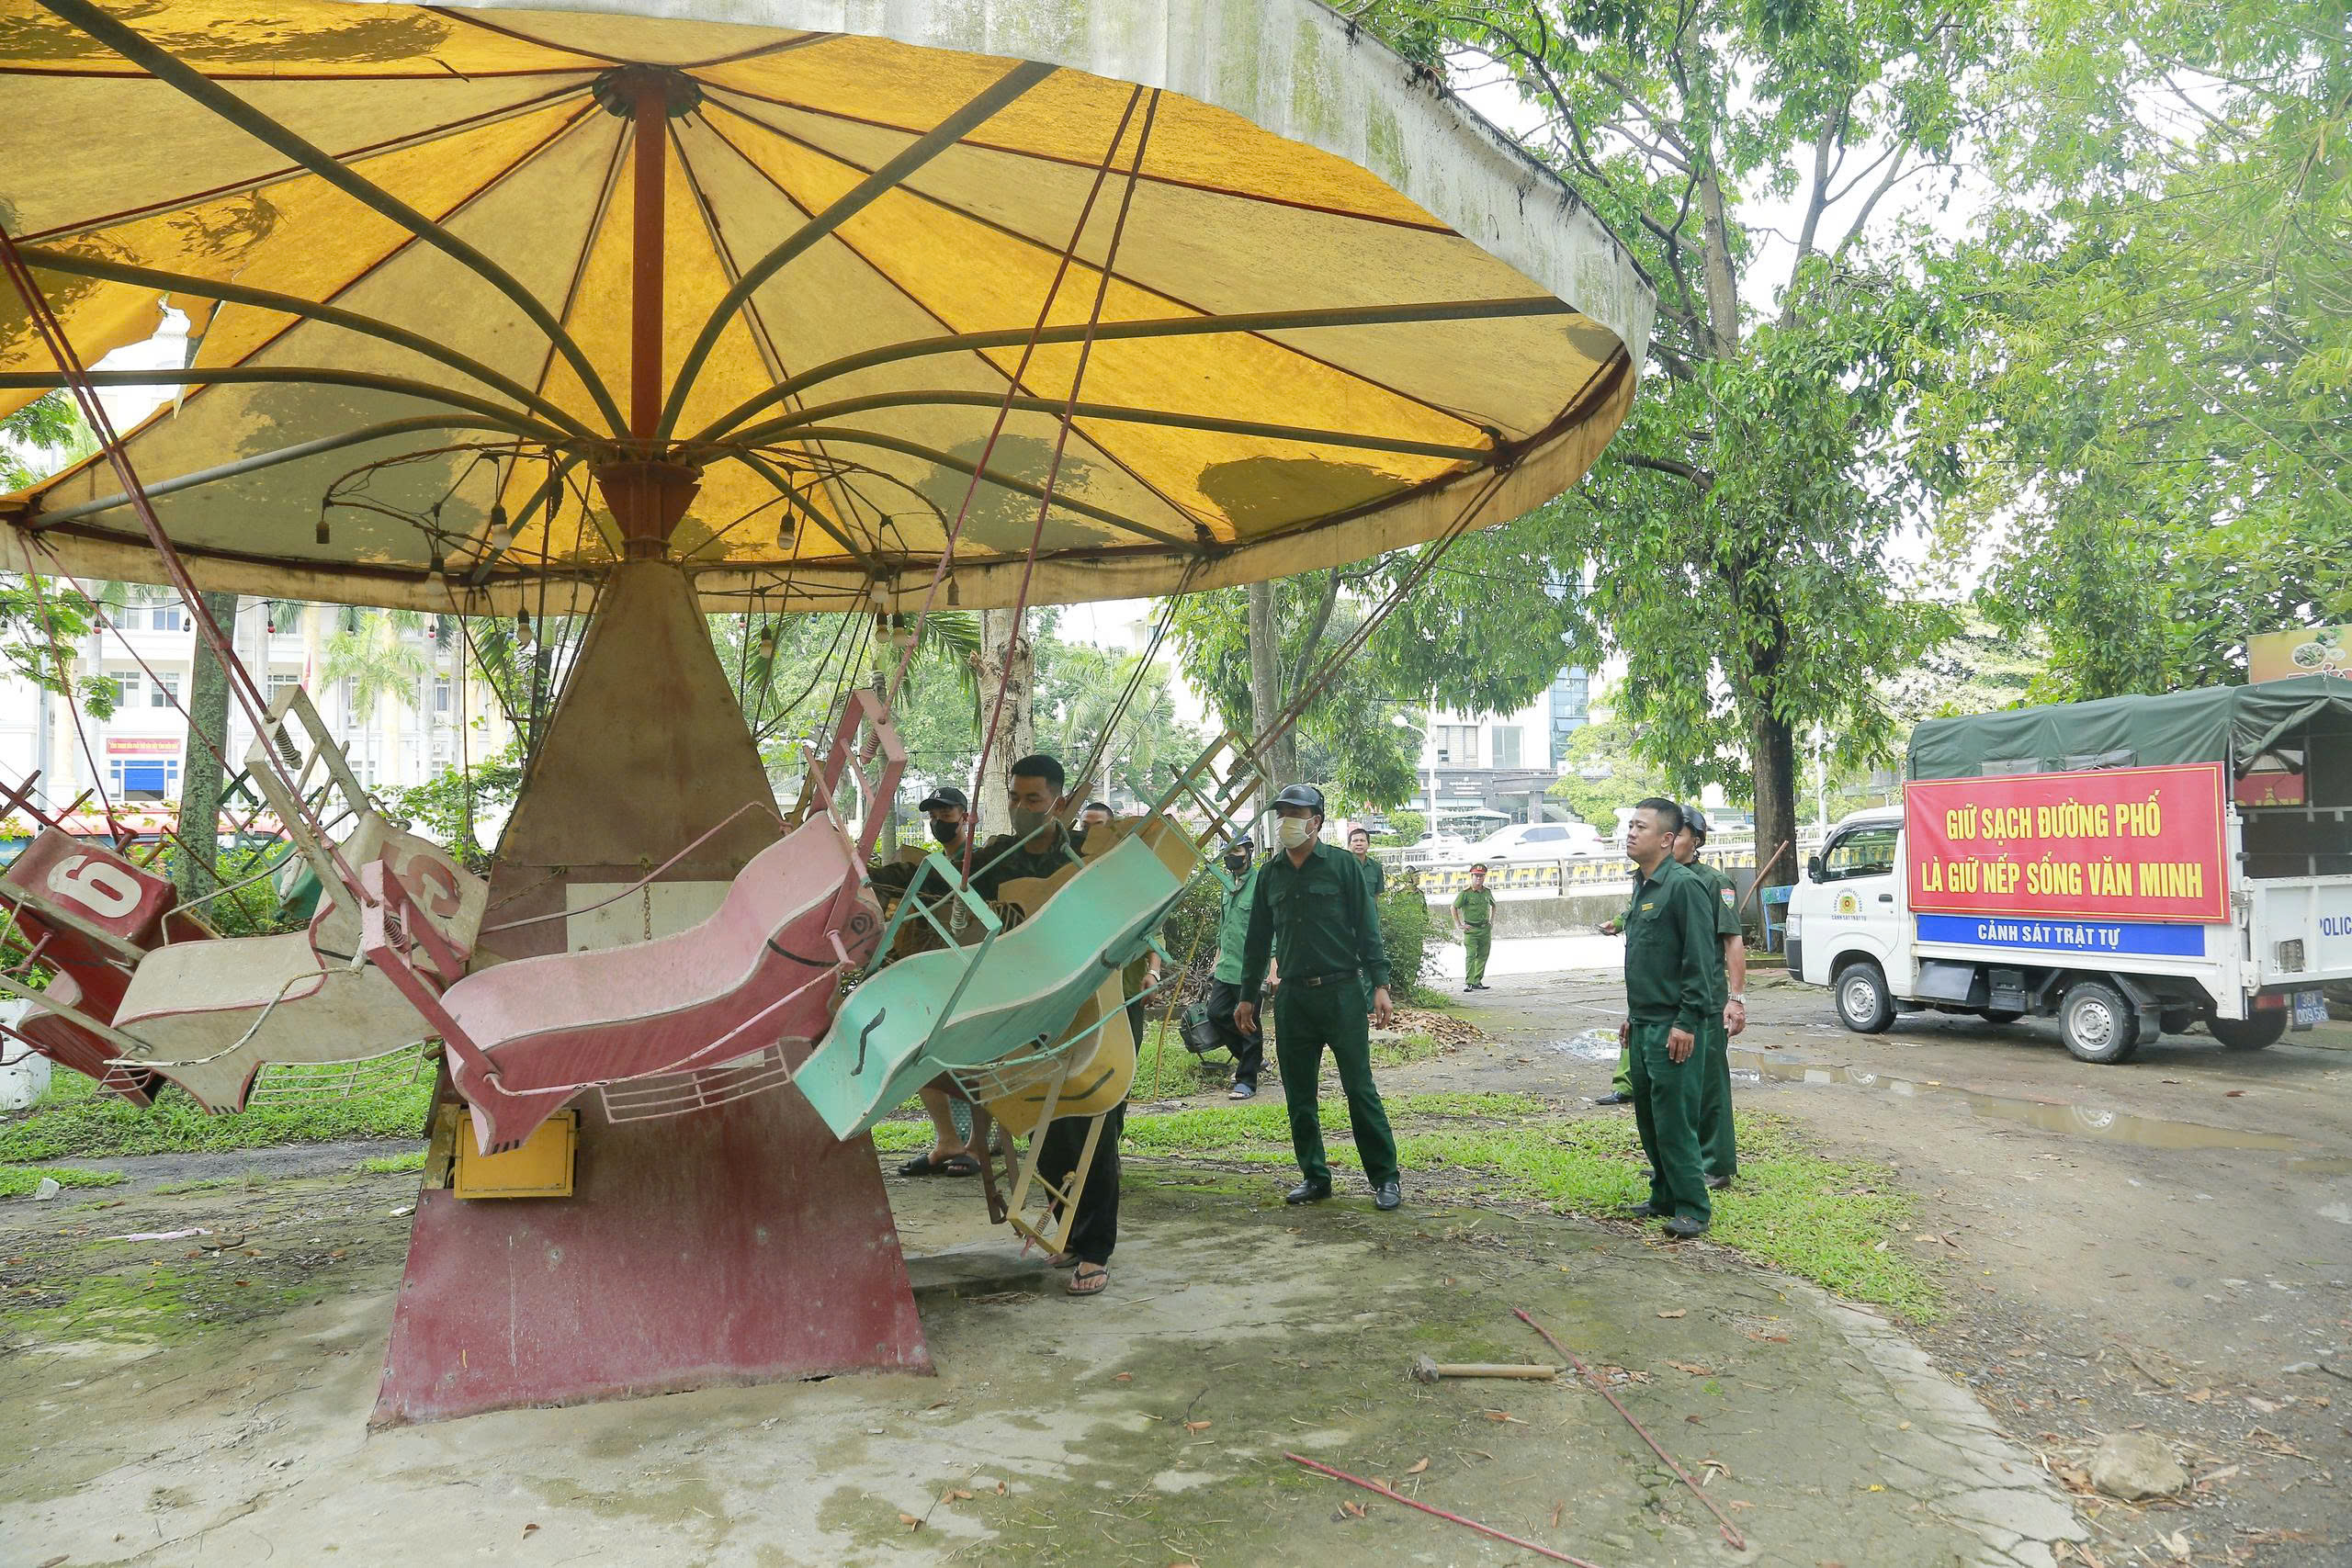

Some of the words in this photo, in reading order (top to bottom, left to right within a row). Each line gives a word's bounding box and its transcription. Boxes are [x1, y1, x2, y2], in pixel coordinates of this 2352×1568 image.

[1946, 803, 1978, 840] GIỮ
[1981, 807, 2032, 846] SẠCH
[2037, 796, 2109, 839] ĐƯỜNG
[2115, 789, 2162, 838] PHỐ
[47, 854, 142, 919] 6
[1921, 855, 1944, 892] LÀ
[1948, 856, 1981, 893] GIỮ
[1983, 852, 2020, 894] NẾP
[2026, 851, 2083, 896] SỐNG
[2087, 855, 2133, 897] VĂN
[2139, 863, 2204, 898] MINH
[1977, 919, 2018, 942] CẢNH
[2022, 923, 2052, 943] SÁT
[2054, 925, 2095, 948] TRẬT
[2098, 928, 2121, 950] TỰ
[2301, 993, 2317, 1007] 36A
